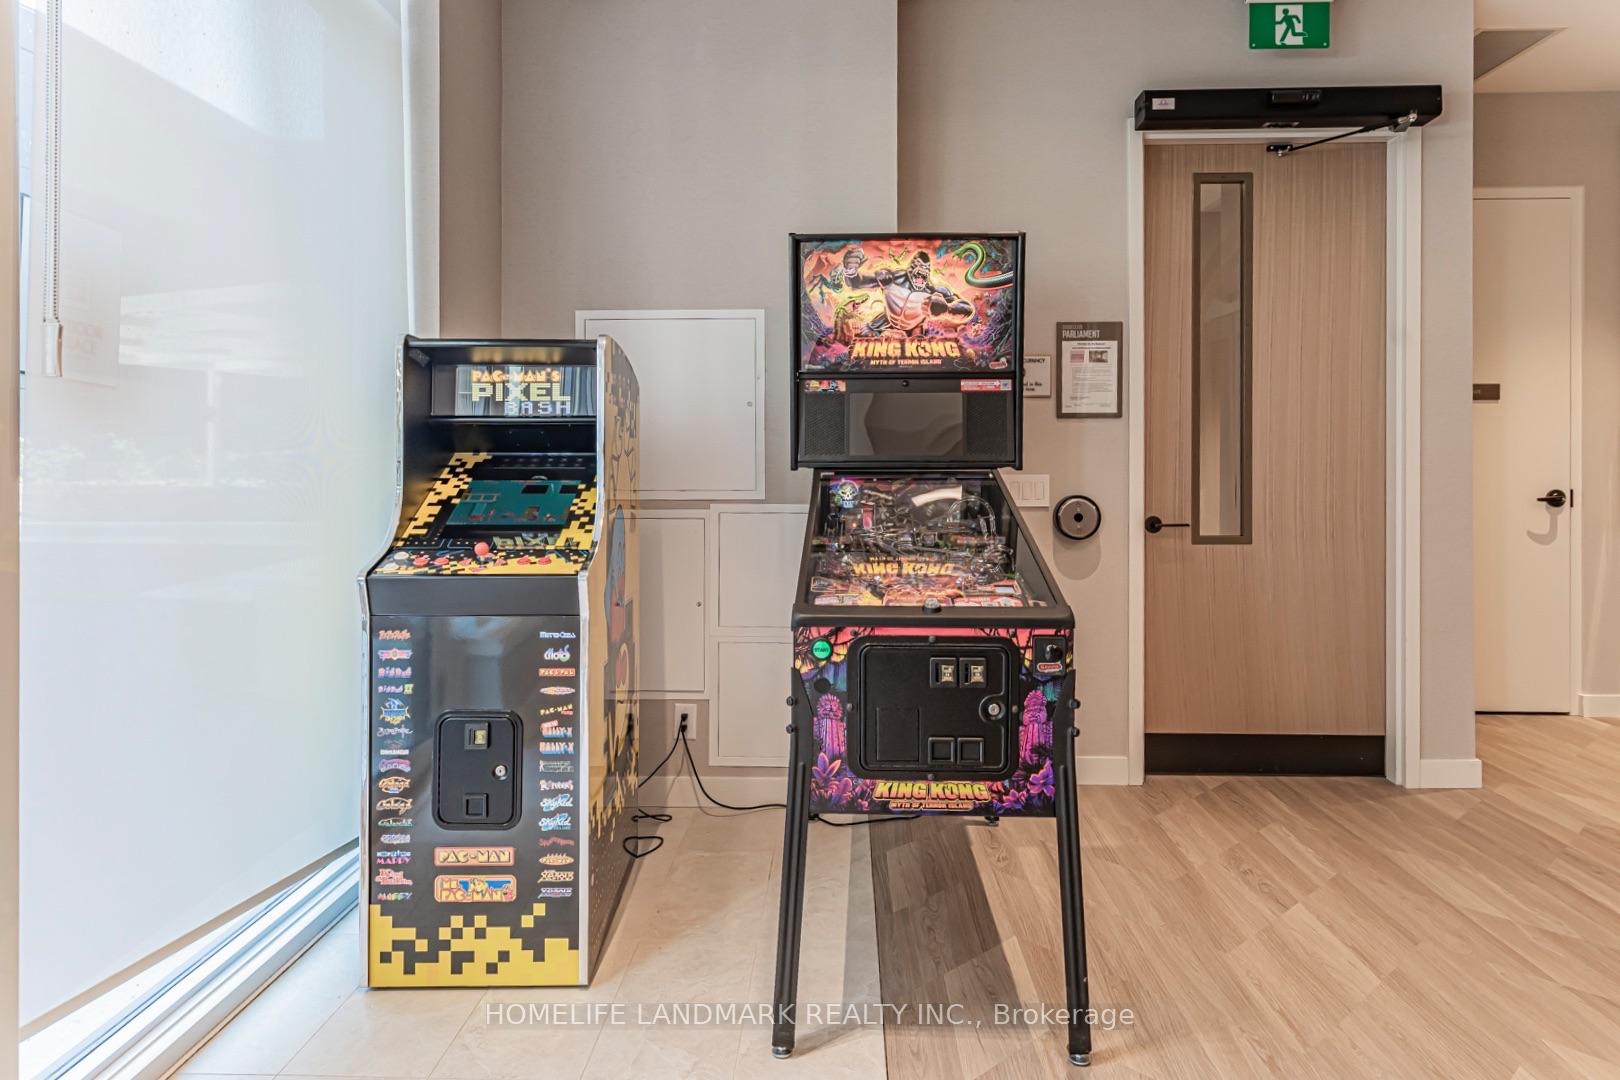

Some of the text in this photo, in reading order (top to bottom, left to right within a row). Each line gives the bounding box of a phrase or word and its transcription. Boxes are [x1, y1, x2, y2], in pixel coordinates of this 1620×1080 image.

[1062, 329, 1100, 338] PARLIAMENT
[853, 340, 960, 358] KING KONG
[471, 368, 561, 382] PAC-MAN'S
[471, 383, 571, 401] PIXEL
[504, 401, 571, 415] BASH
[877, 782, 989, 800] KING KONG
[439, 850, 510, 863] PAC-MAN
